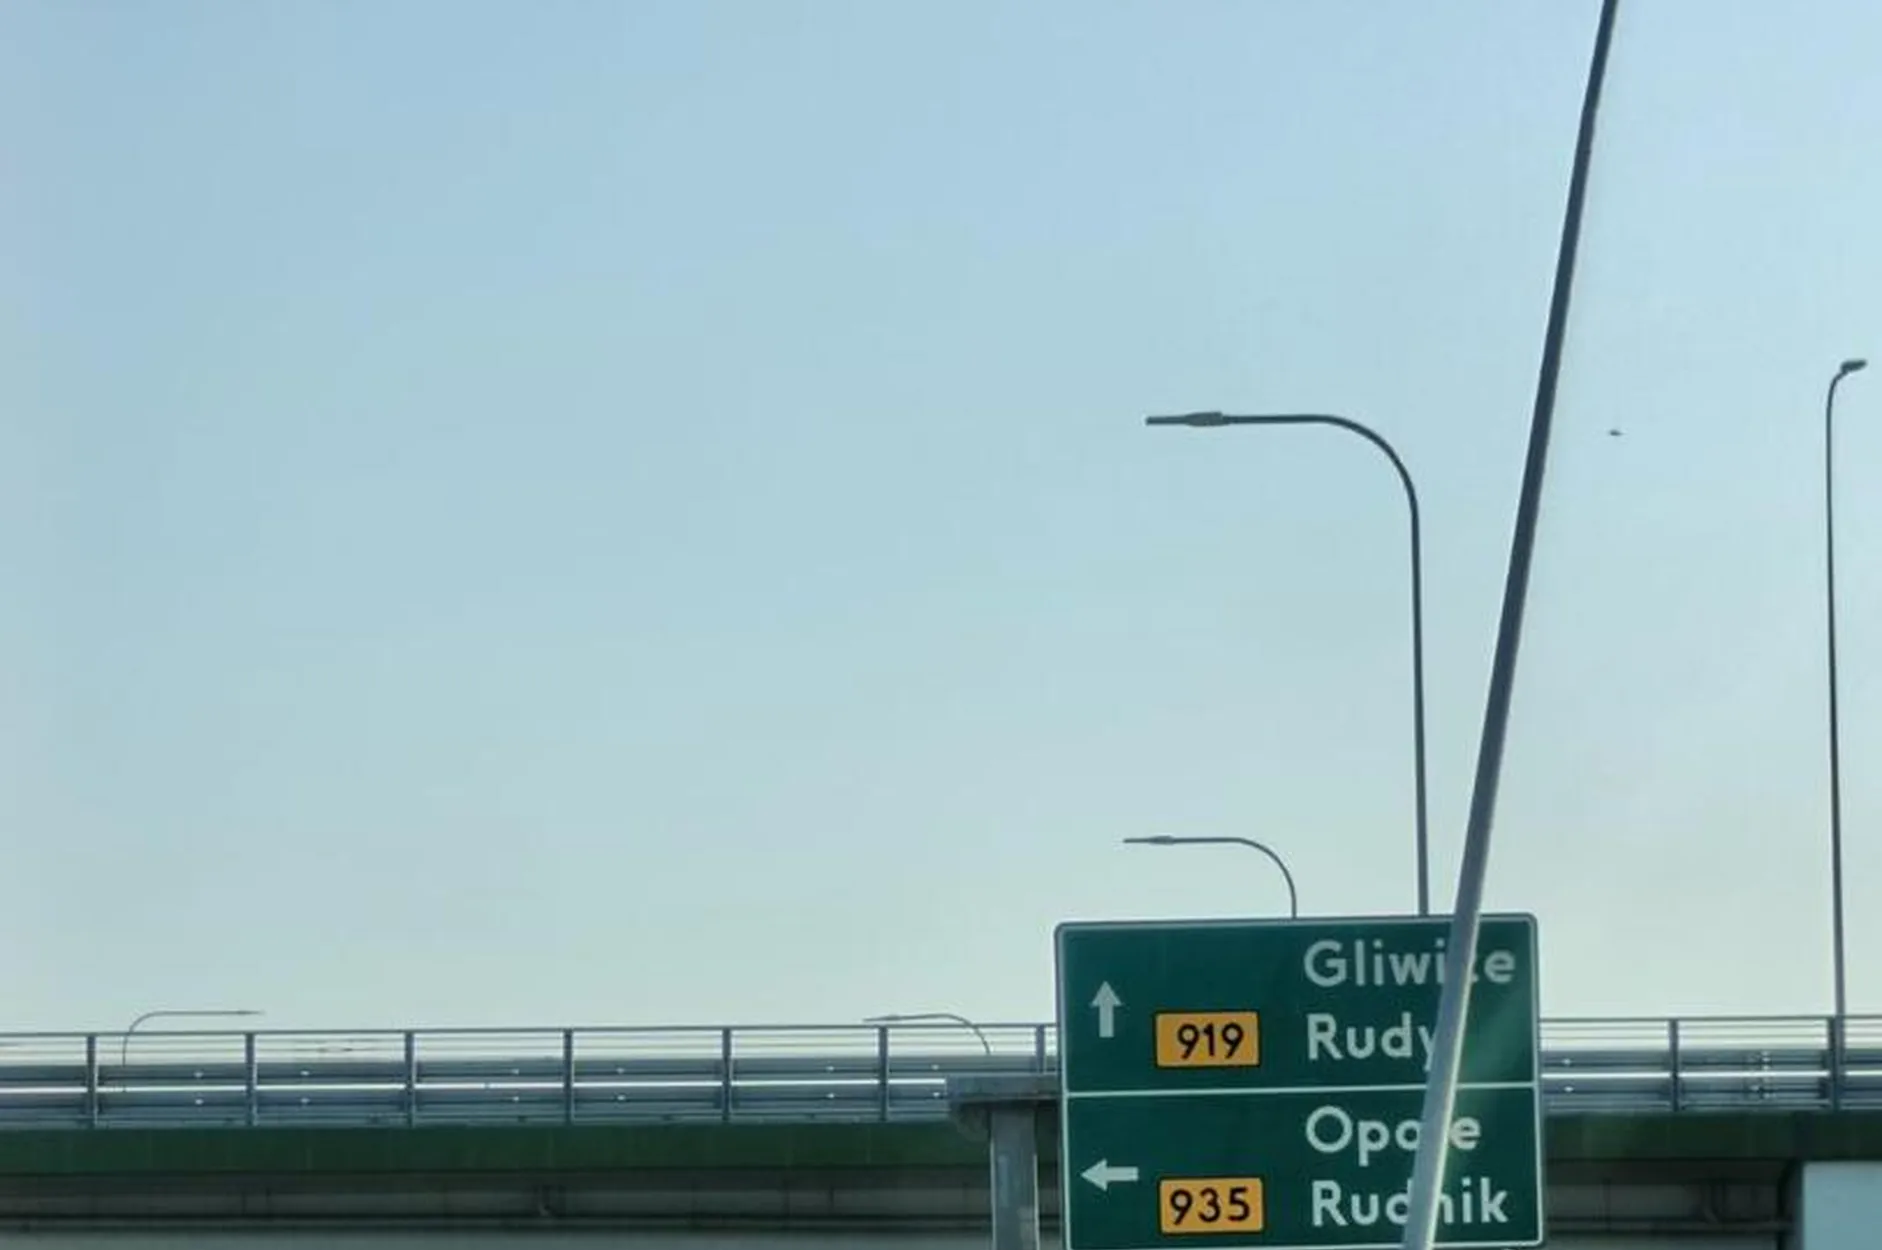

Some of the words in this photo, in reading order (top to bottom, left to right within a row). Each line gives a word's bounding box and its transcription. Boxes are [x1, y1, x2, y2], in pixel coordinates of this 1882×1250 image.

[1304, 938, 1516, 987] Gliwie
[1177, 1022, 1244, 1060] 919
[1305, 1105, 1481, 1167] Opoe
[1169, 1186, 1250, 1225] 935
